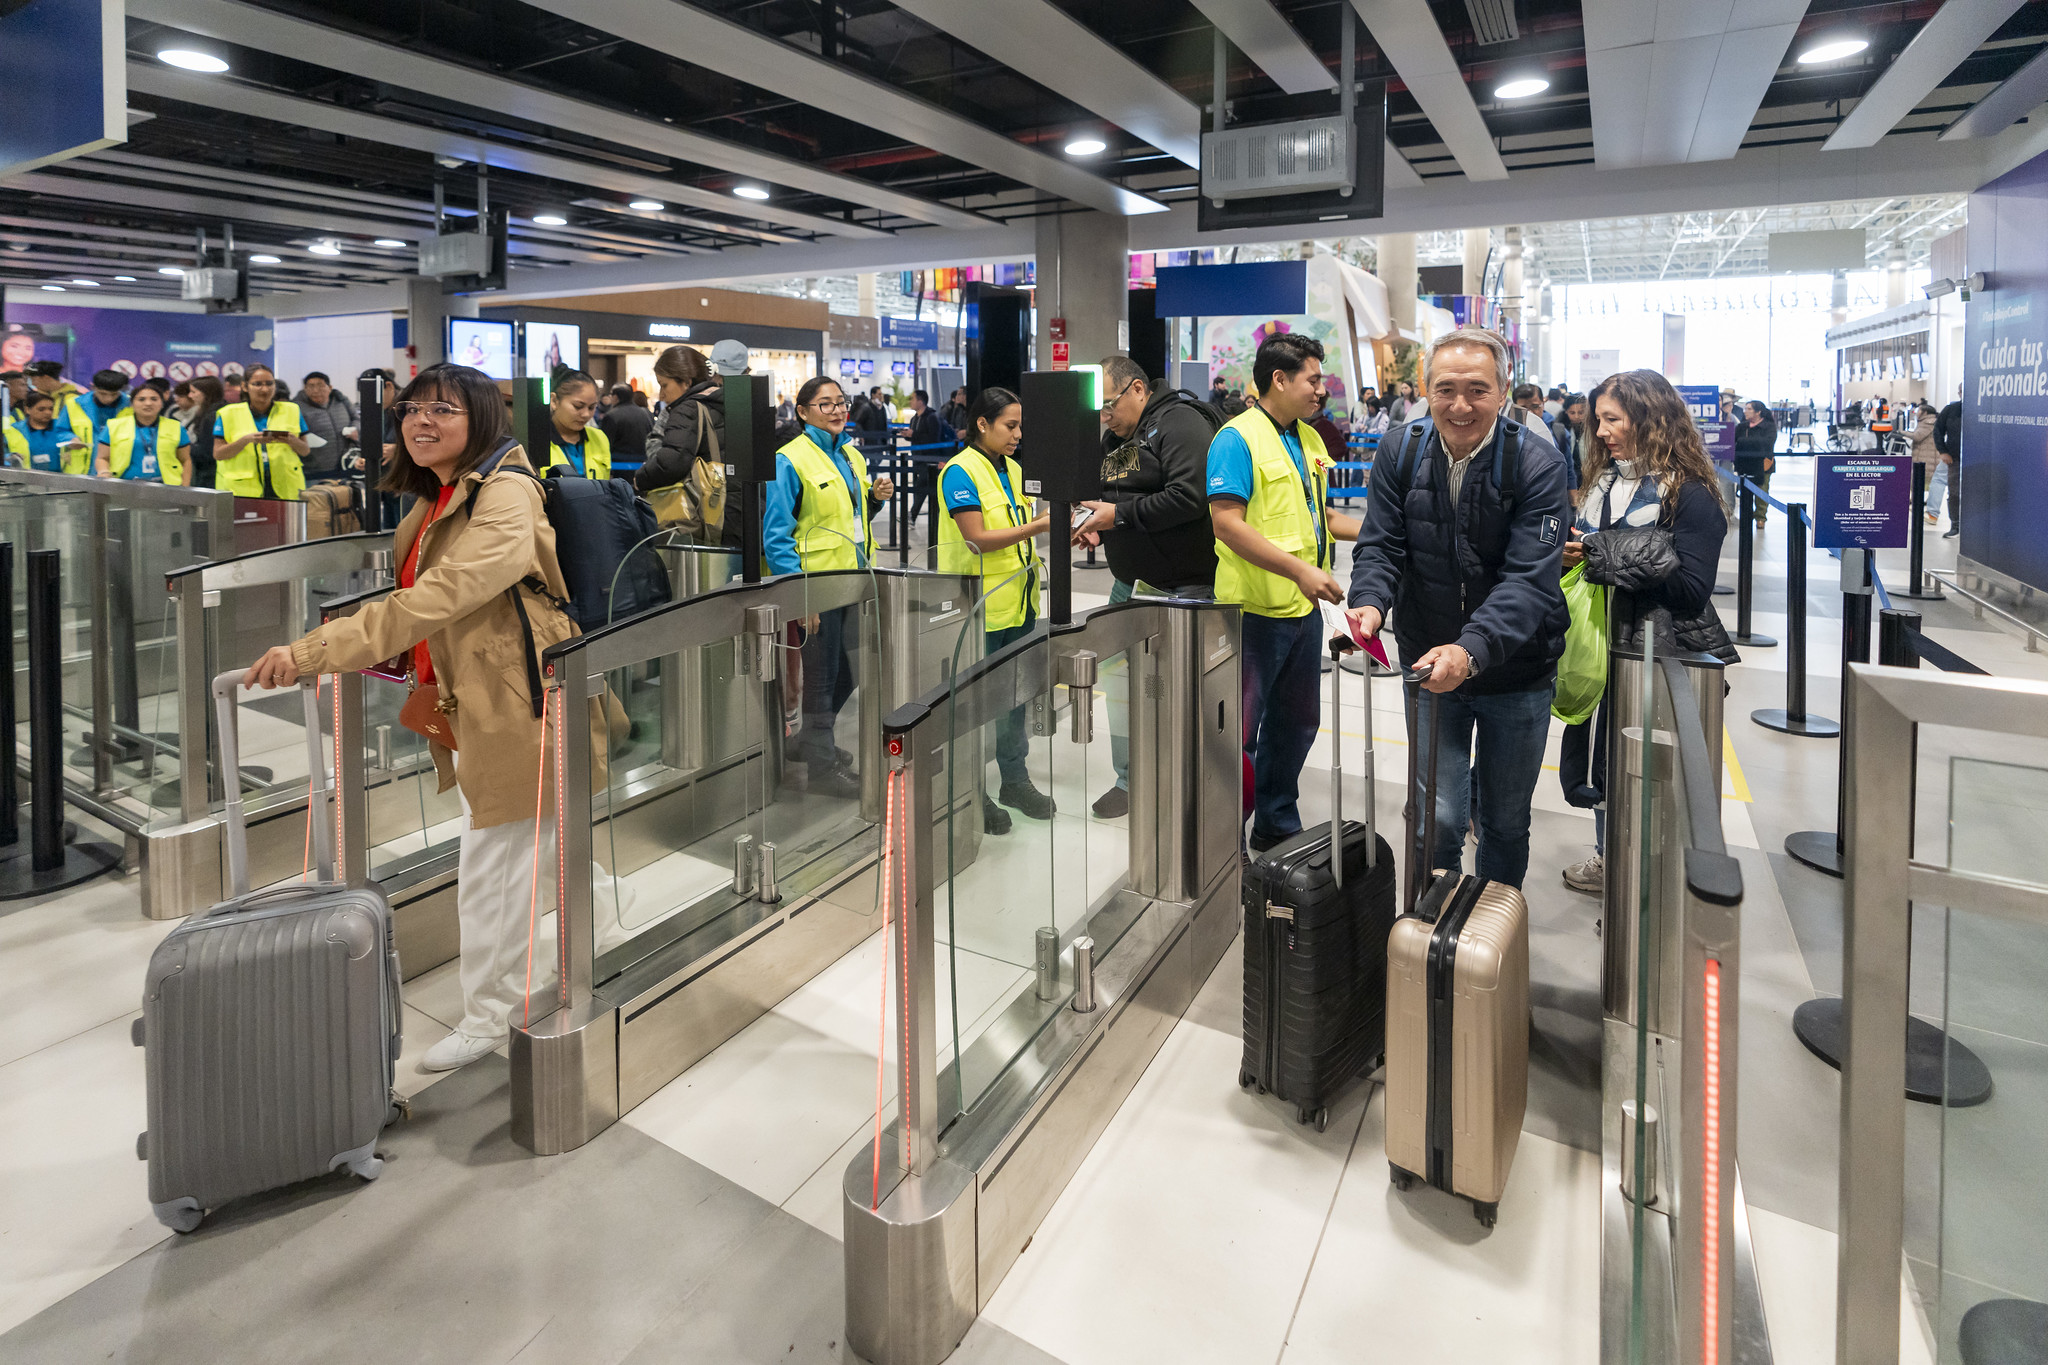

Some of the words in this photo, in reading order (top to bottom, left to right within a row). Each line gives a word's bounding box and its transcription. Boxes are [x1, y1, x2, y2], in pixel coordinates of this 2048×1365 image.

[1979, 337, 2017, 370] Cuida
[2020, 338, 2043, 367] tus
[1977, 360, 2048, 406] personale
[1987, 414, 1996, 423] CARE
[2003, 415, 2013, 424] YOUR
[2014, 416, 2036, 426] PERSONAL
